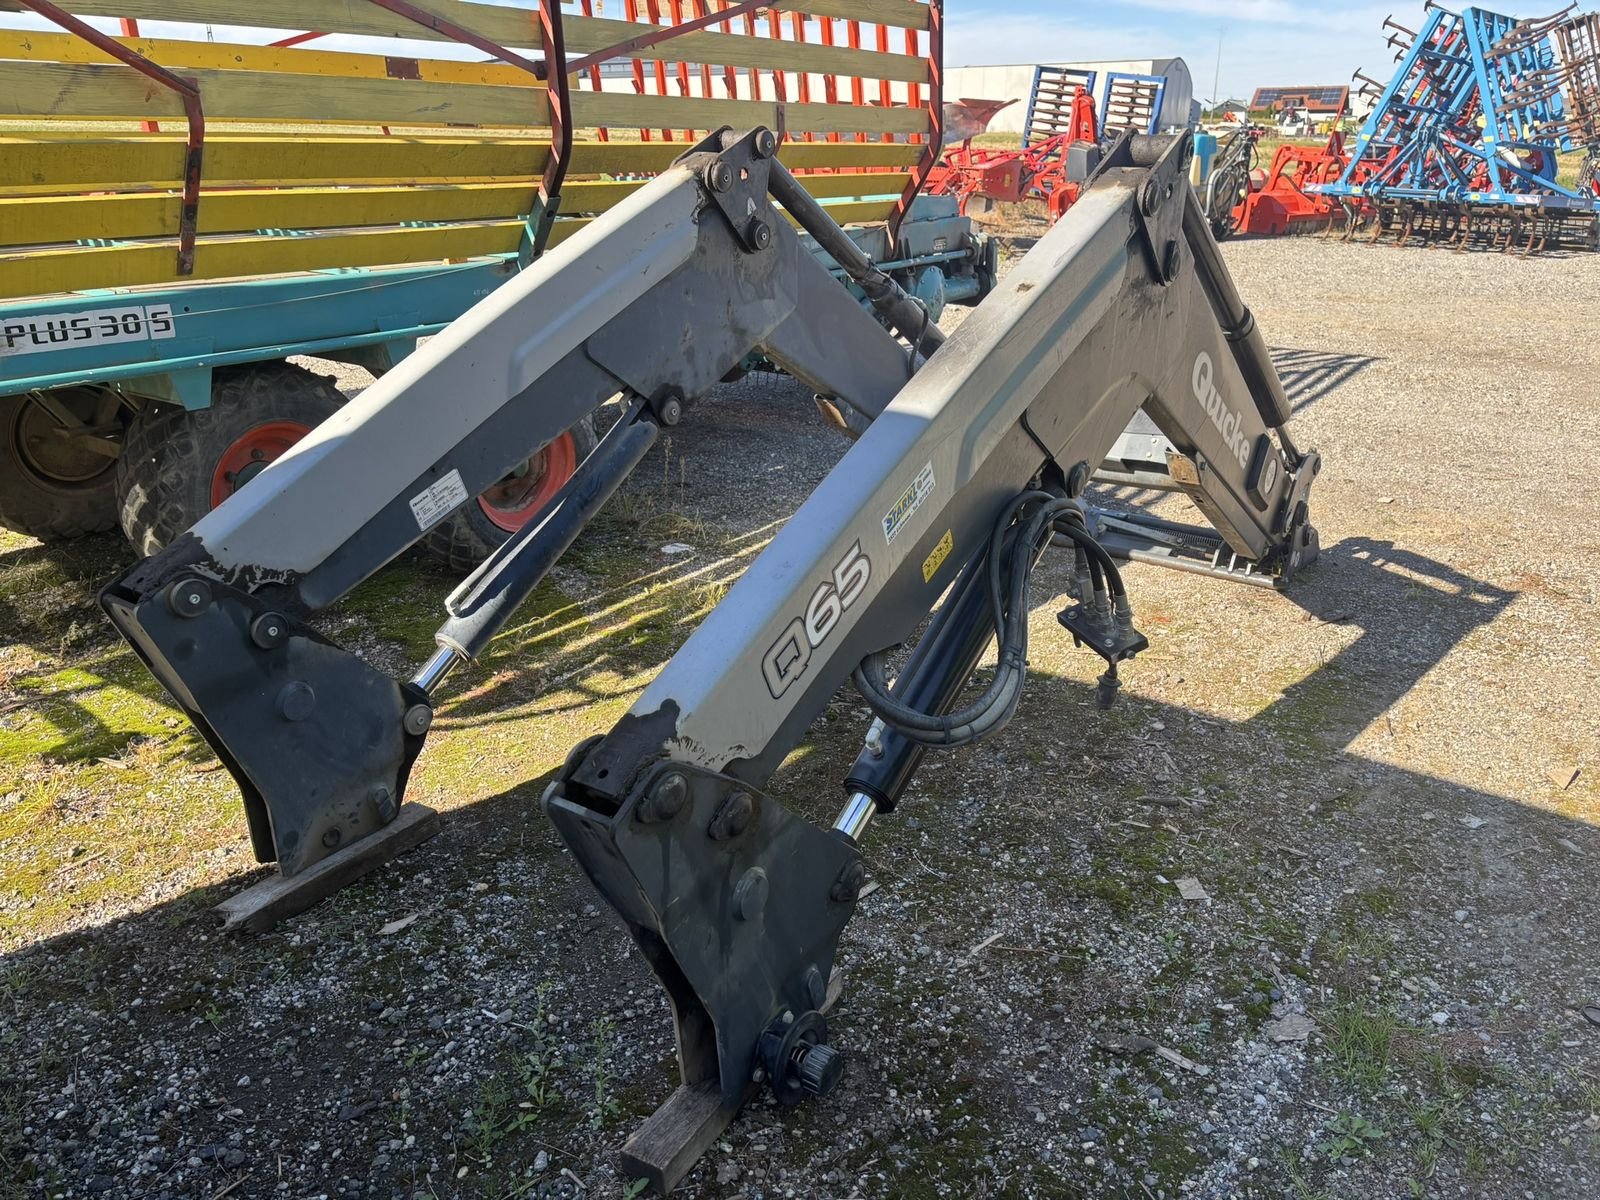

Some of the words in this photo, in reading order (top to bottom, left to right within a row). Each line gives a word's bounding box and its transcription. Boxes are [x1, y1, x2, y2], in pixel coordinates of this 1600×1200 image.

[5, 317, 92, 348] PLUS
[99, 313, 142, 338] 30
[1191, 351, 1251, 470] Quicke
[761, 535, 872, 700] Q65
